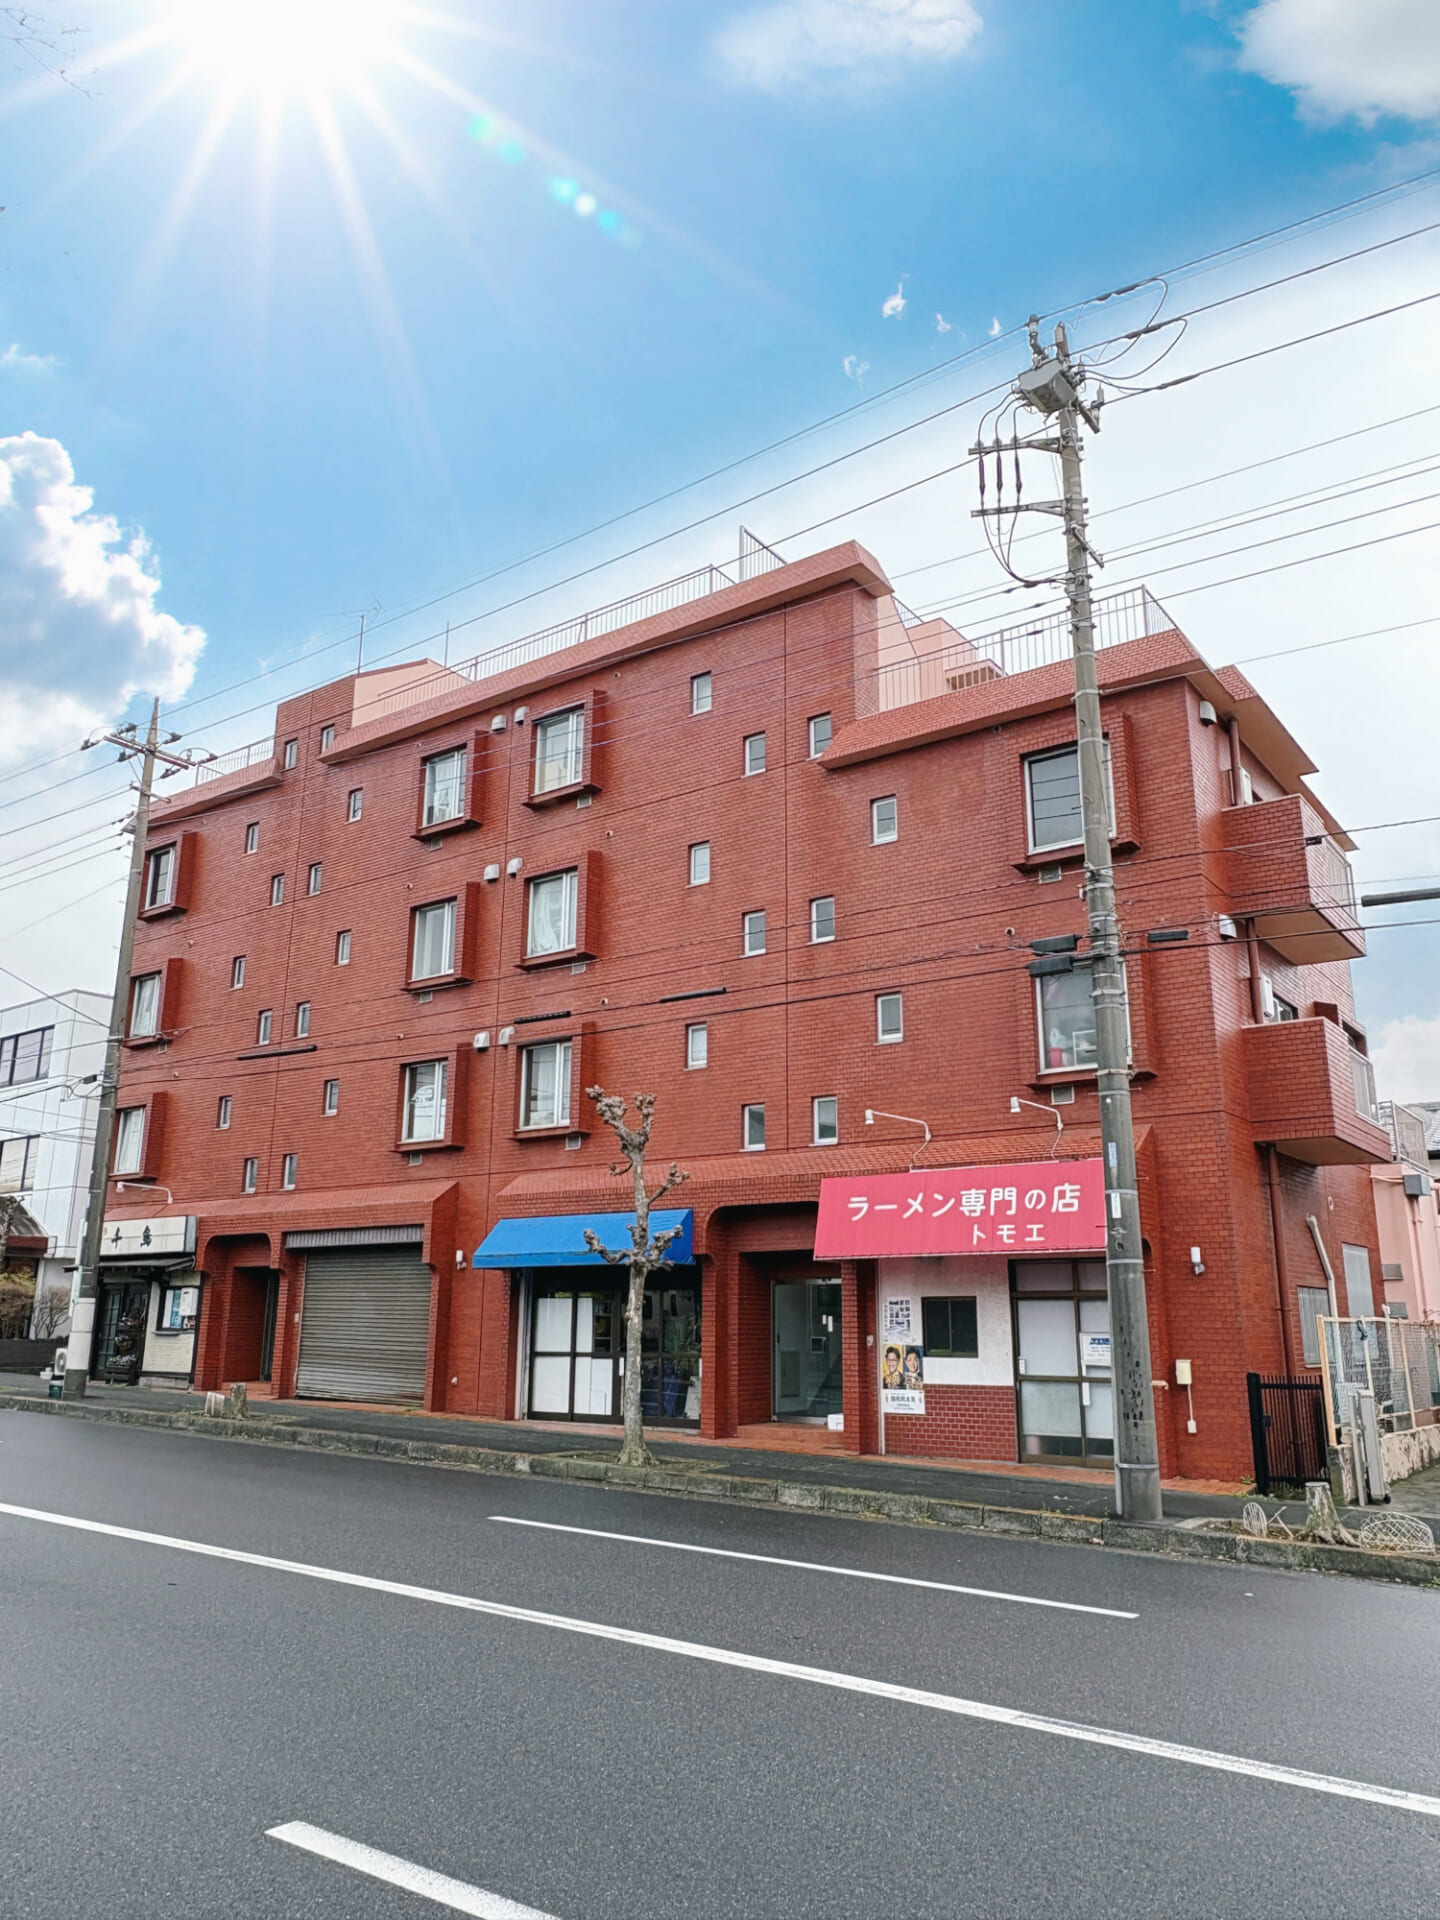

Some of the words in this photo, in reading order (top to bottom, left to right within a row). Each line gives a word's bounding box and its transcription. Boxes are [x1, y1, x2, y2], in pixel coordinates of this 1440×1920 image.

[848, 1183, 1081, 1221] ラーメン専門の店
[972, 1223, 1045, 1246] トモエ
